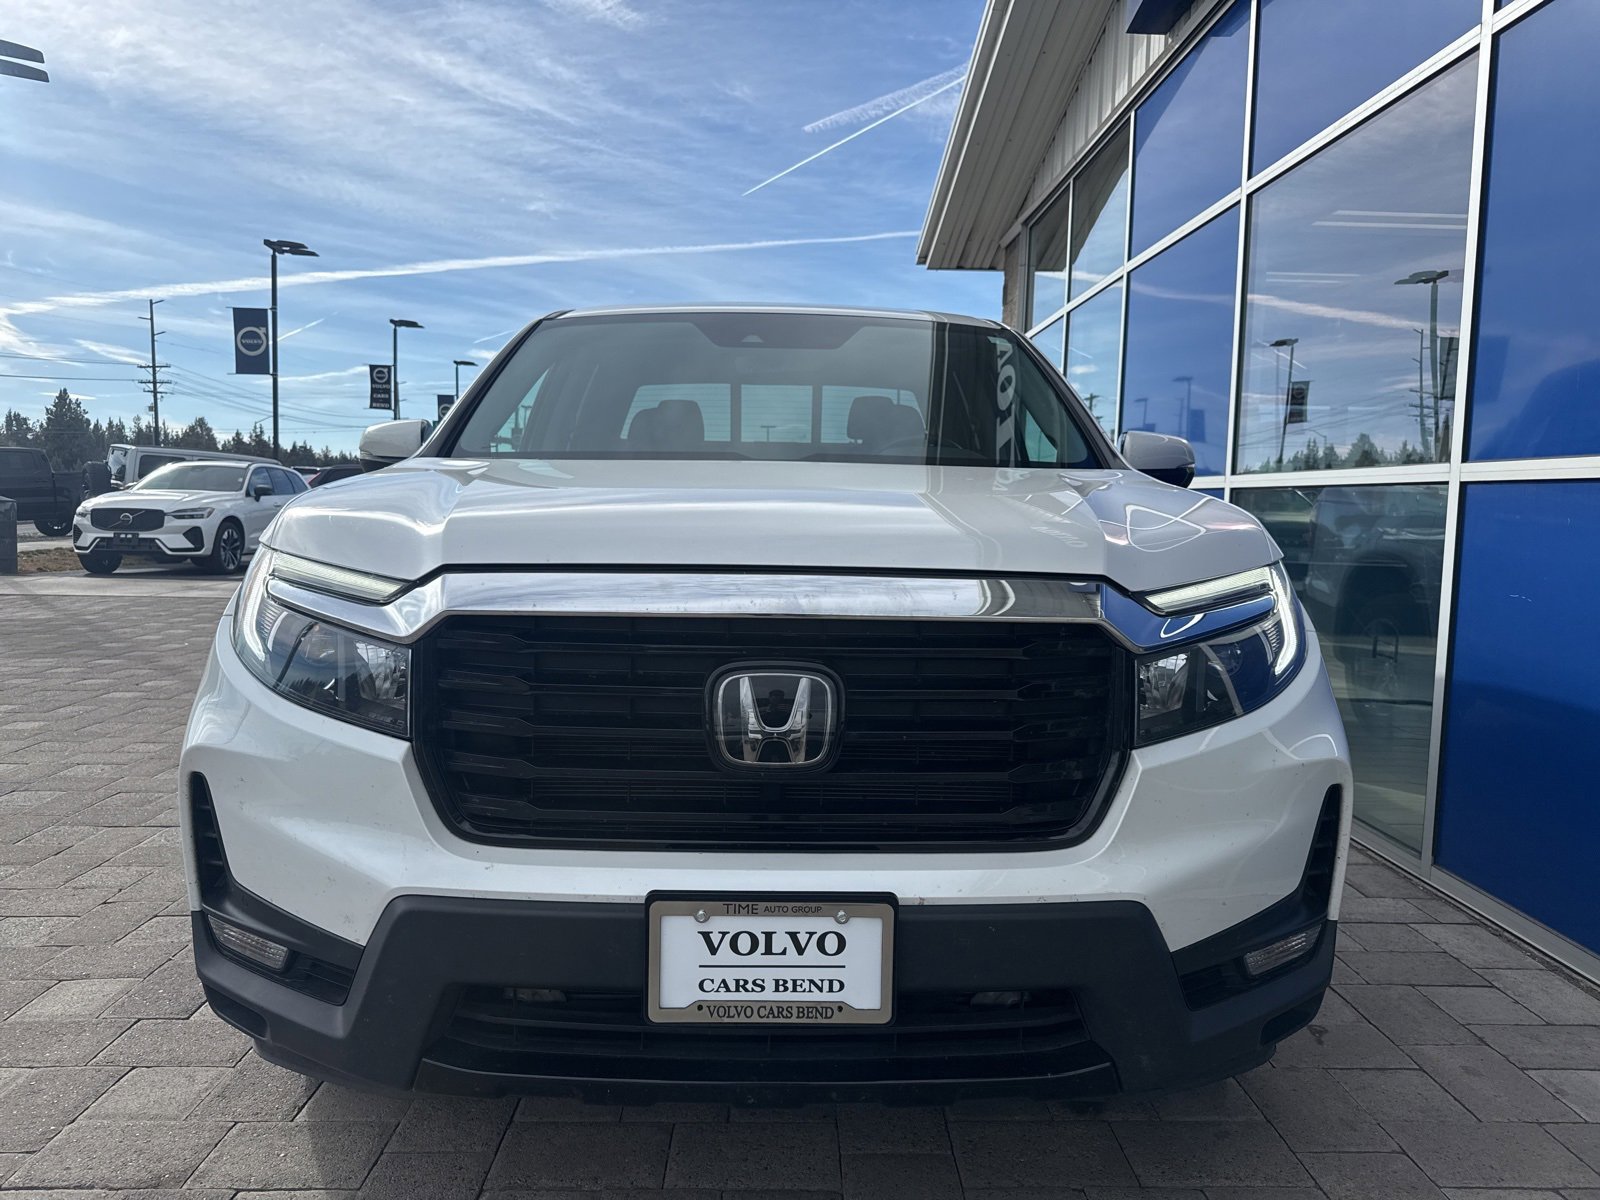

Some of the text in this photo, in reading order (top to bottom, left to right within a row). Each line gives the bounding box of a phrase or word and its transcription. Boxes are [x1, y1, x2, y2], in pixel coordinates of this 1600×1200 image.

[722, 903, 822, 915] TIME AUTO GROUP
[697, 930, 847, 957] VOLVO
[698, 978, 845, 994] CARS BEND
[706, 1005, 835, 1020] VOLVO CARS BEND
